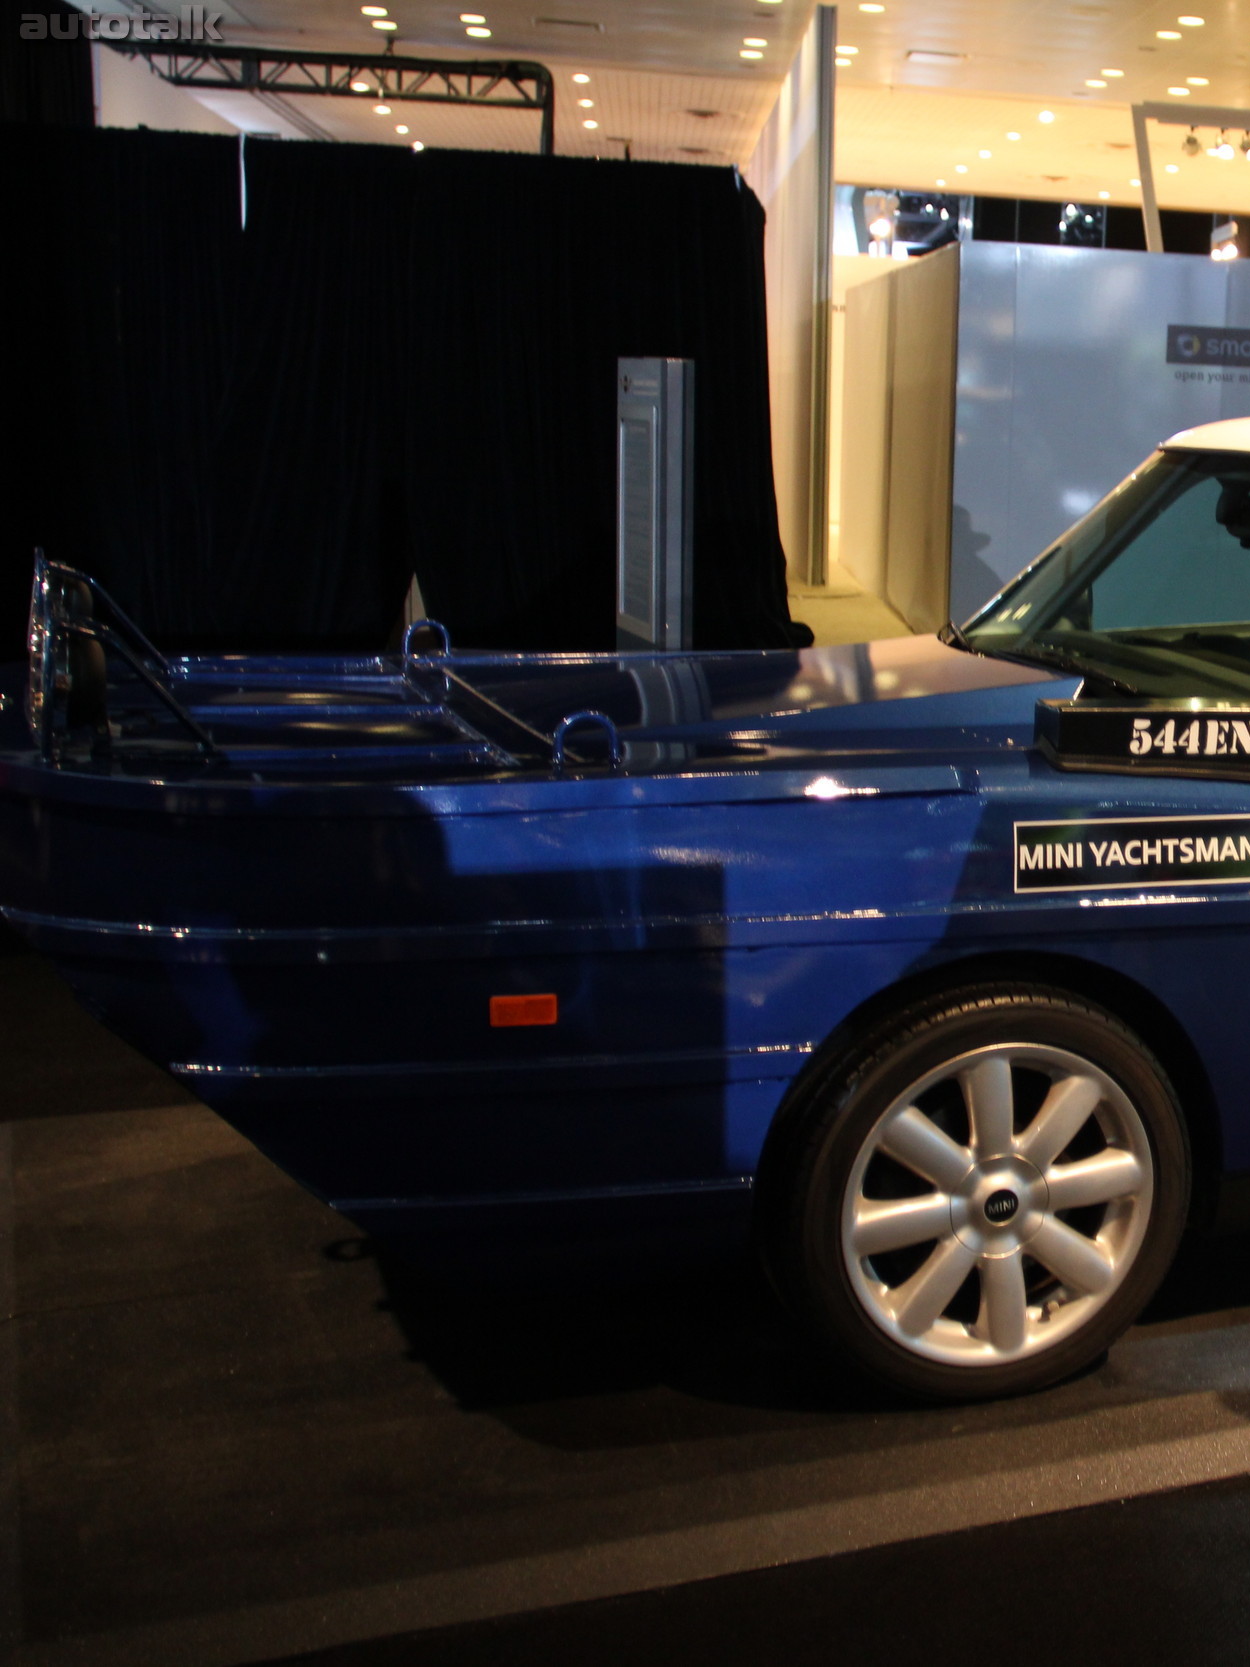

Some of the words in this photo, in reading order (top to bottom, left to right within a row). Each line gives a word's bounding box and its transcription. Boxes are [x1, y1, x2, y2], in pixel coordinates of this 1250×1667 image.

[1174, 370, 1204, 382] open
[1207, 372, 1234, 384] your
[1018, 841, 1083, 871] MINI
[988, 1198, 1015, 1214] MINI
